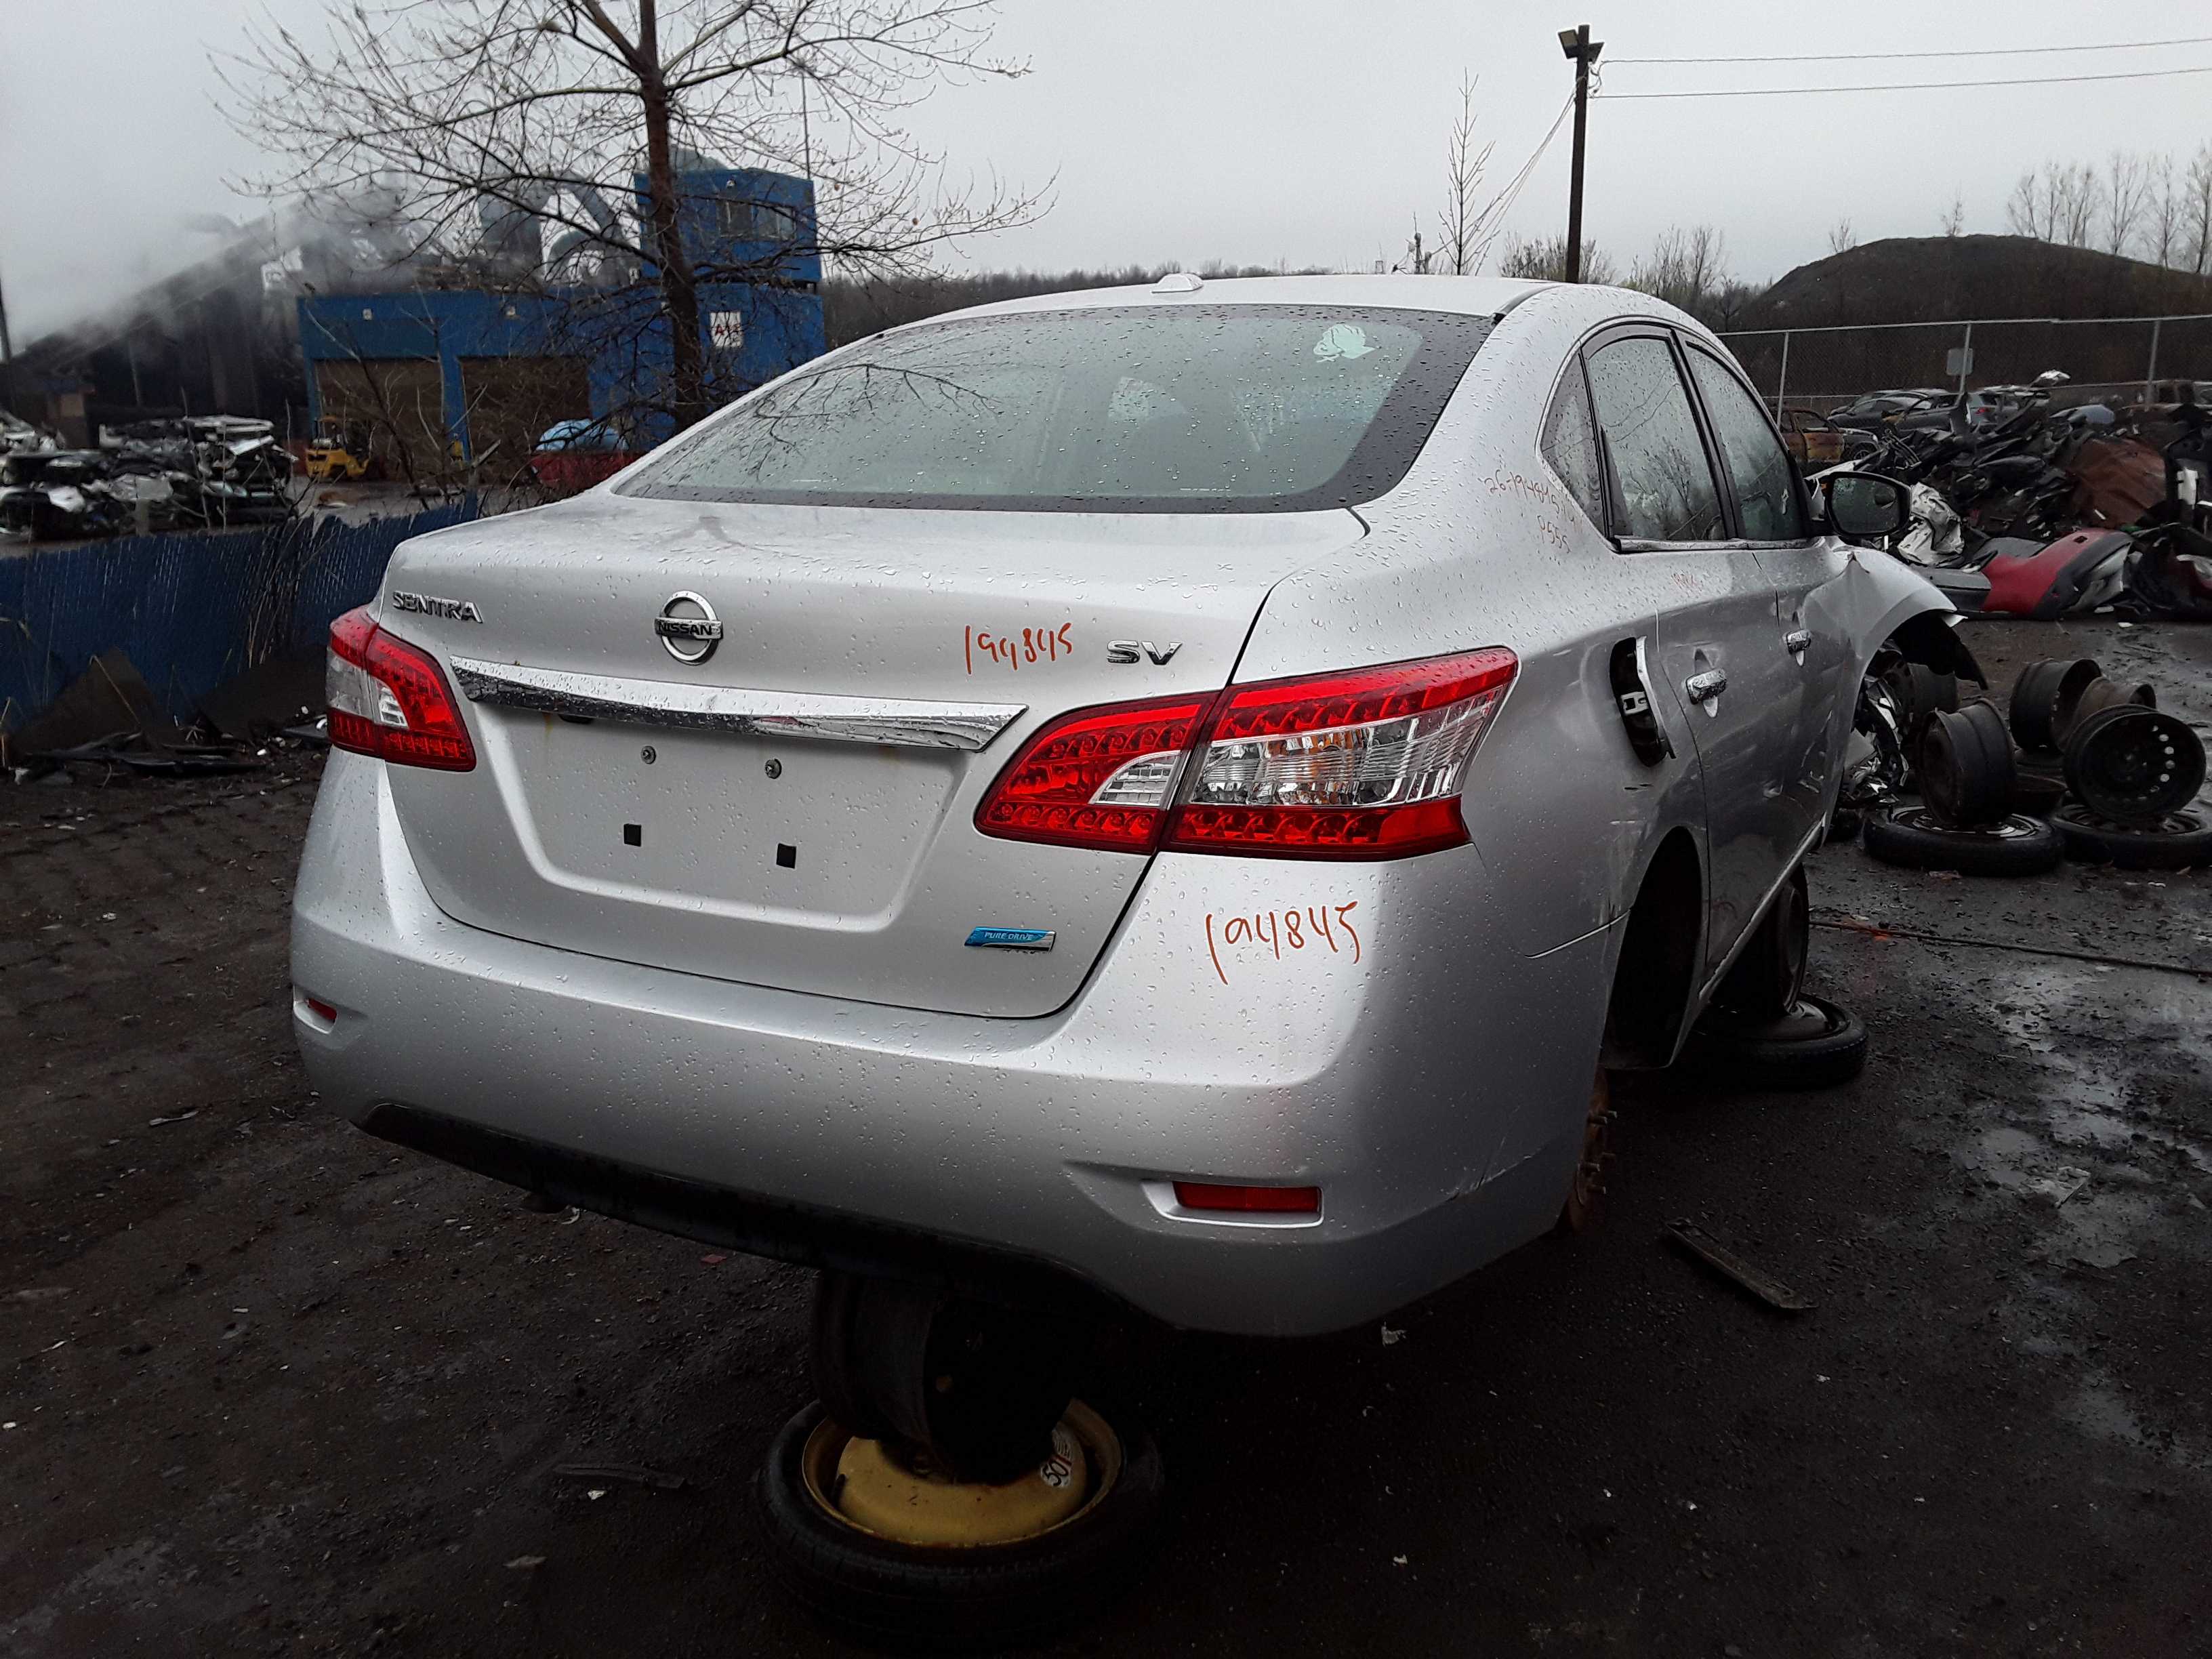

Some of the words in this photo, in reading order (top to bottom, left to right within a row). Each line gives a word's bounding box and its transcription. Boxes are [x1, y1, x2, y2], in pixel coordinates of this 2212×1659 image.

[392, 590, 483, 624] SENTRA
[658, 621, 713, 636] NISSAN
[964, 623, 1073, 675] 194845
[1105, 640, 1183, 665] SV
[984, 931, 1007, 939] PURE
[1008, 933, 1034, 941] DRIVE
[1206, 900, 1361, 985] 194845
[1042, 1460, 1069, 1486] 50
